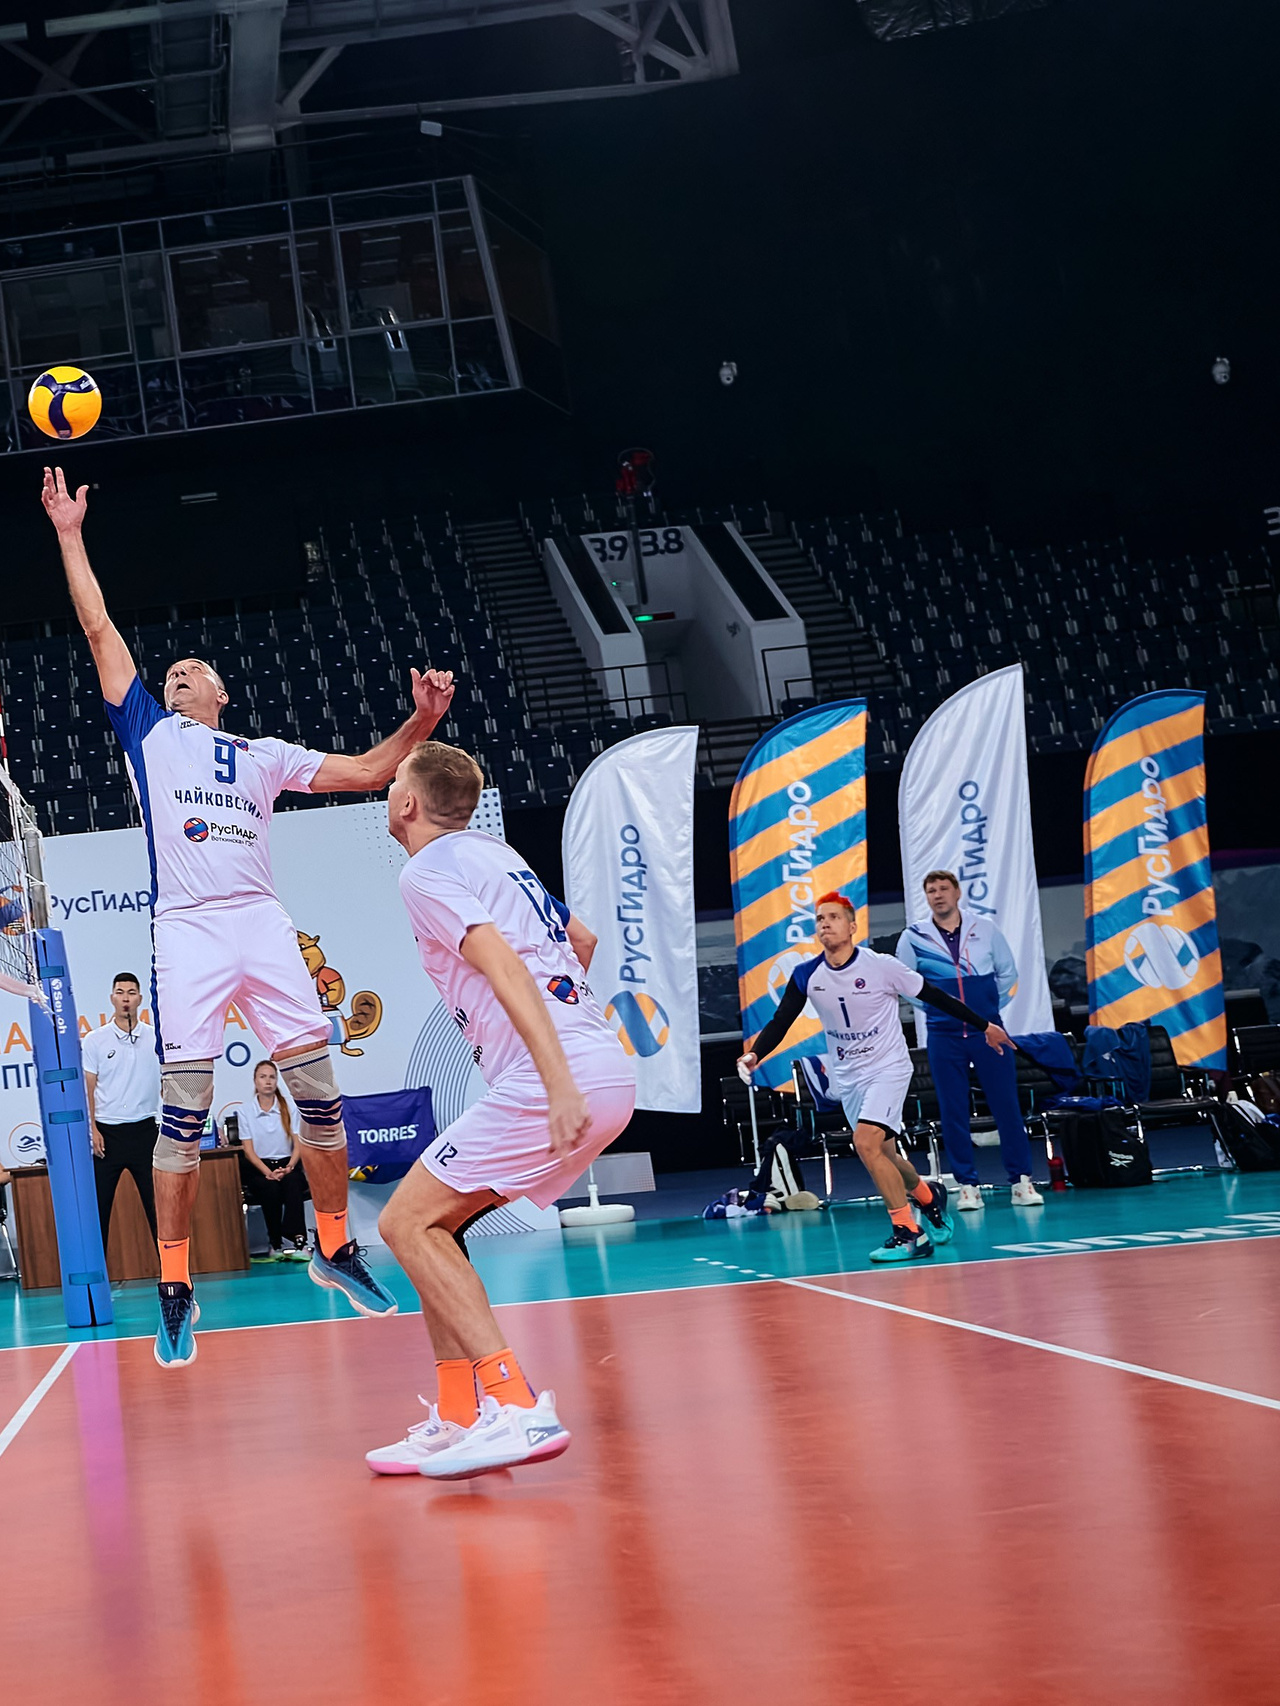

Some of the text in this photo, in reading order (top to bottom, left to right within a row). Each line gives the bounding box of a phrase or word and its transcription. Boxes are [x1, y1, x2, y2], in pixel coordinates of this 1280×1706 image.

[639, 528, 684, 557] 3.8
[213, 736, 236, 785] 9
[782, 781, 819, 944] РусГидро
[958, 780, 997, 916] усГидро
[1138, 756, 1180, 917] РусГидро
[617, 824, 652, 984] РусГидро
[357, 1124, 417, 1144] TORRES
[435, 1142, 458, 1167] 12
